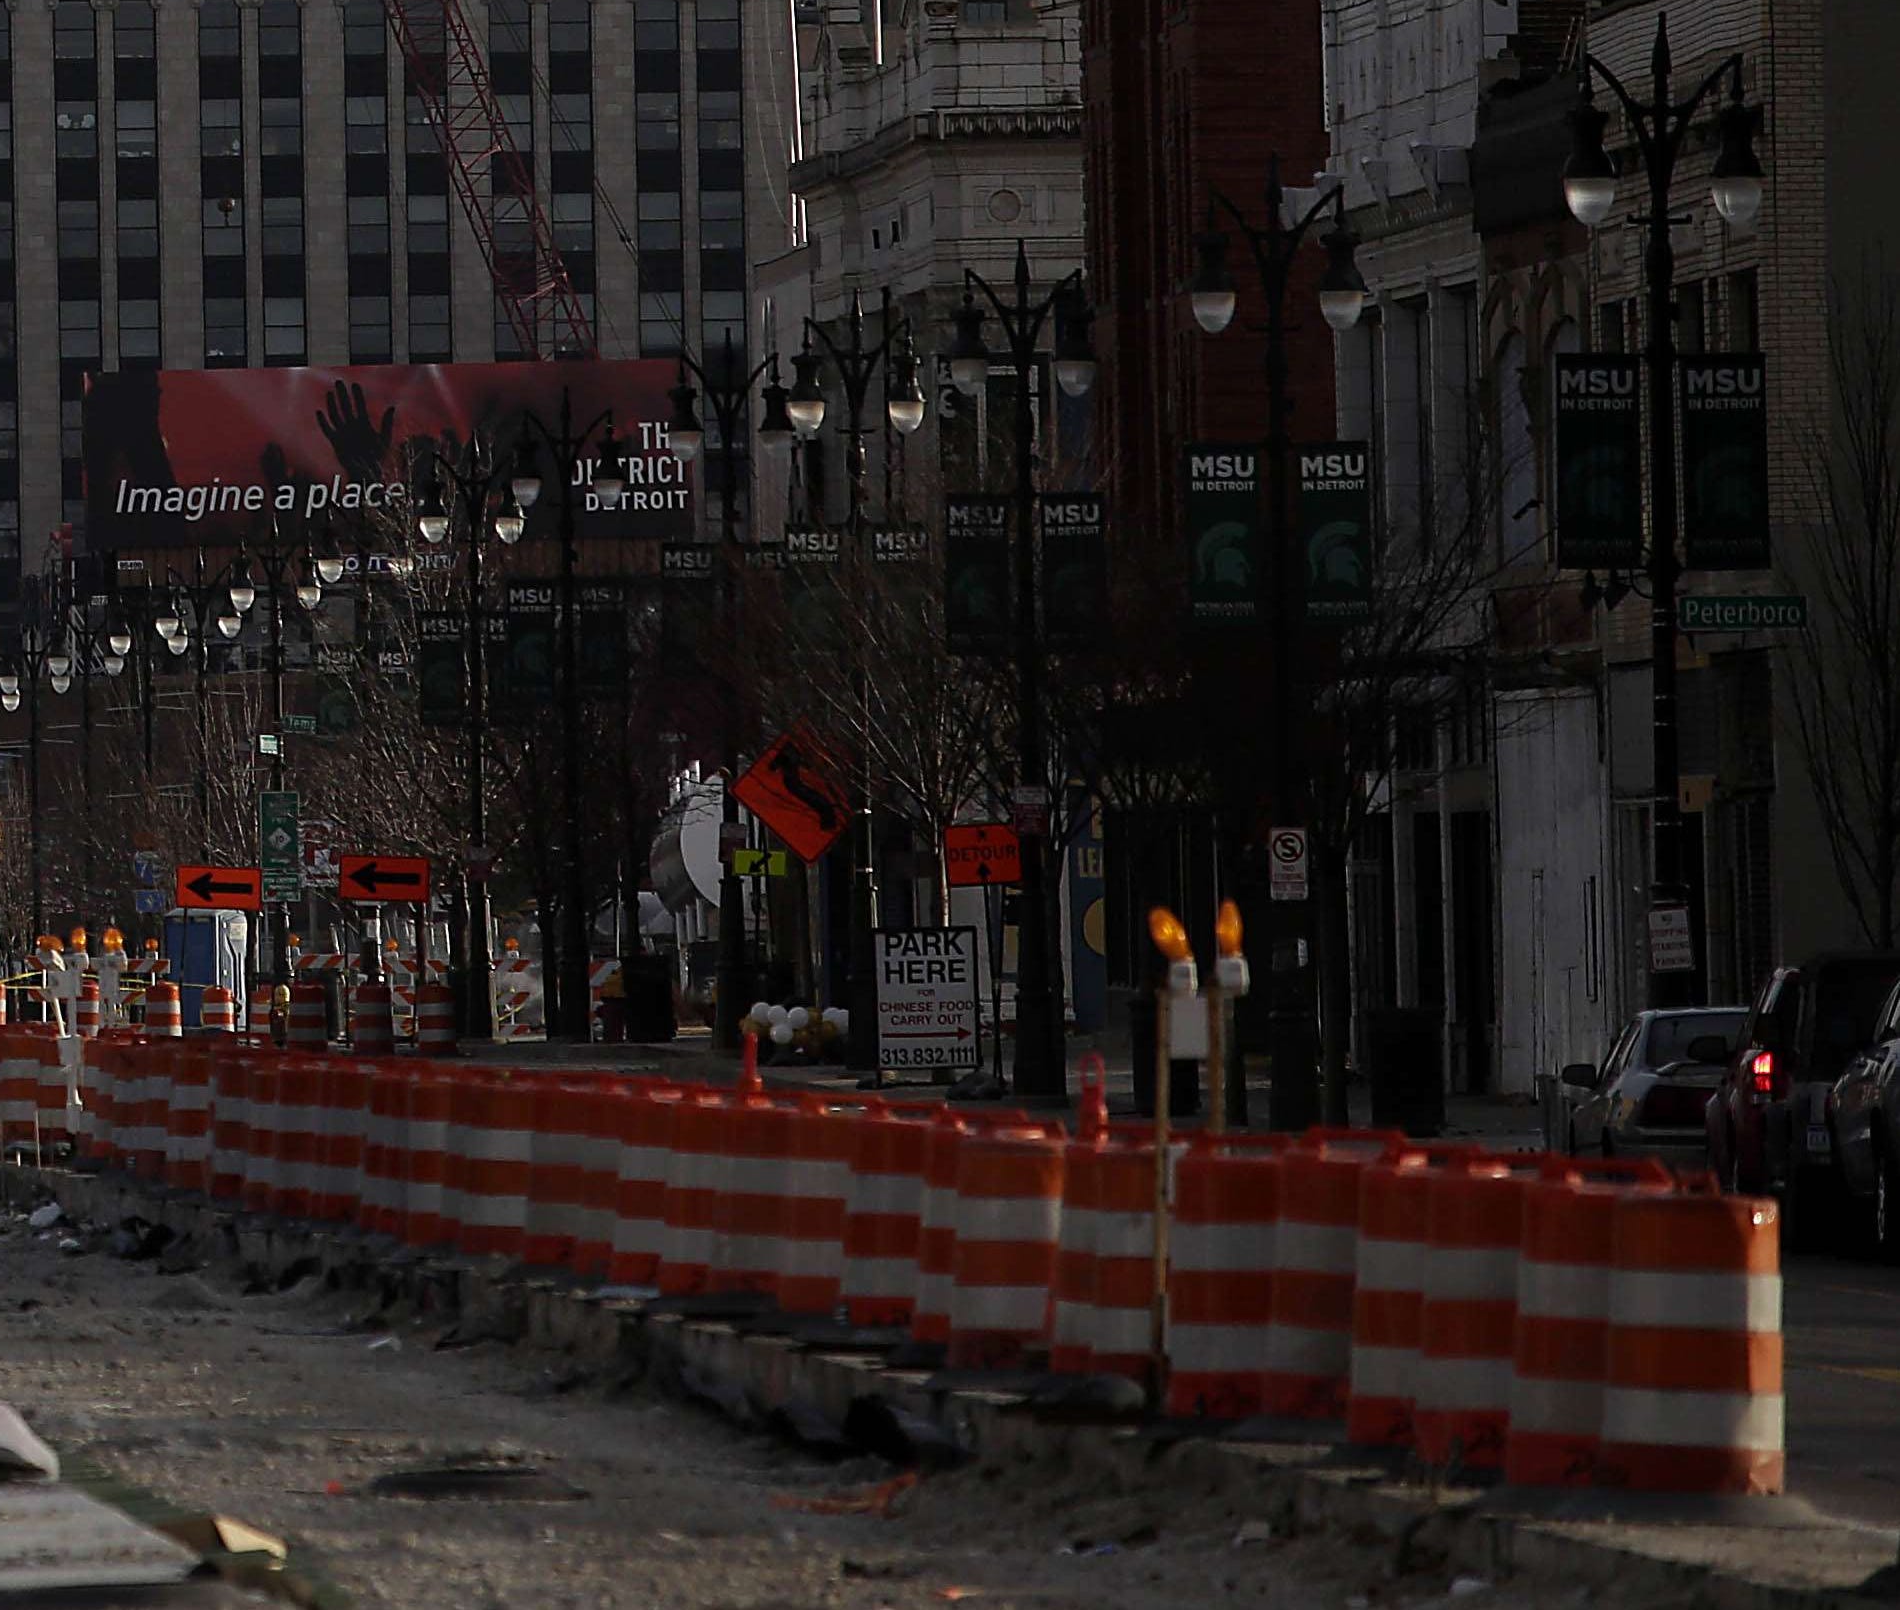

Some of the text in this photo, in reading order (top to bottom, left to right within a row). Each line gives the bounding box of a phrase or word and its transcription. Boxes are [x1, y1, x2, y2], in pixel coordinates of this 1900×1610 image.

[1560, 368, 1634, 395] MSU
[1687, 368, 1762, 395] MSU
[1561, 397, 1635, 410] IN DETROIT
[1688, 397, 1762, 410] IN DETROIT
[638, 422, 671, 450] TH
[1192, 455, 1255, 477] MSU
[1301, 454, 1364, 477] MSU
[1192, 481, 1255, 492] IN DETROIT
[1302, 479, 1365, 491] IN DETROIT
[116, 477, 265, 522] Imagine
[274, 484, 296, 510] a
[585, 490, 689, 511] DTROIT
[948, 505, 1005, 525] MSU
[1043, 504, 1100, 524] MSU
[1057, 525, 1101, 536] DETROIT
[788, 533, 839, 552] MSU
[875, 532, 926, 552] MSU
[665, 550, 712, 569] MSU
[509, 588, 553, 605] MSU
[1686, 600, 1801, 624] Peterboro
[950, 845, 1016, 862] DETOUR
[885, 931, 963, 956] PARK
[885, 960, 967, 983] HERE
[918, 989, 936, 997] FOR
[880, 1000, 975, 1012] CHINESE FOOD
[891, 1014, 964, 1025] CARRY OUT
[881, 1047, 975, 1064] 313.832.1111
